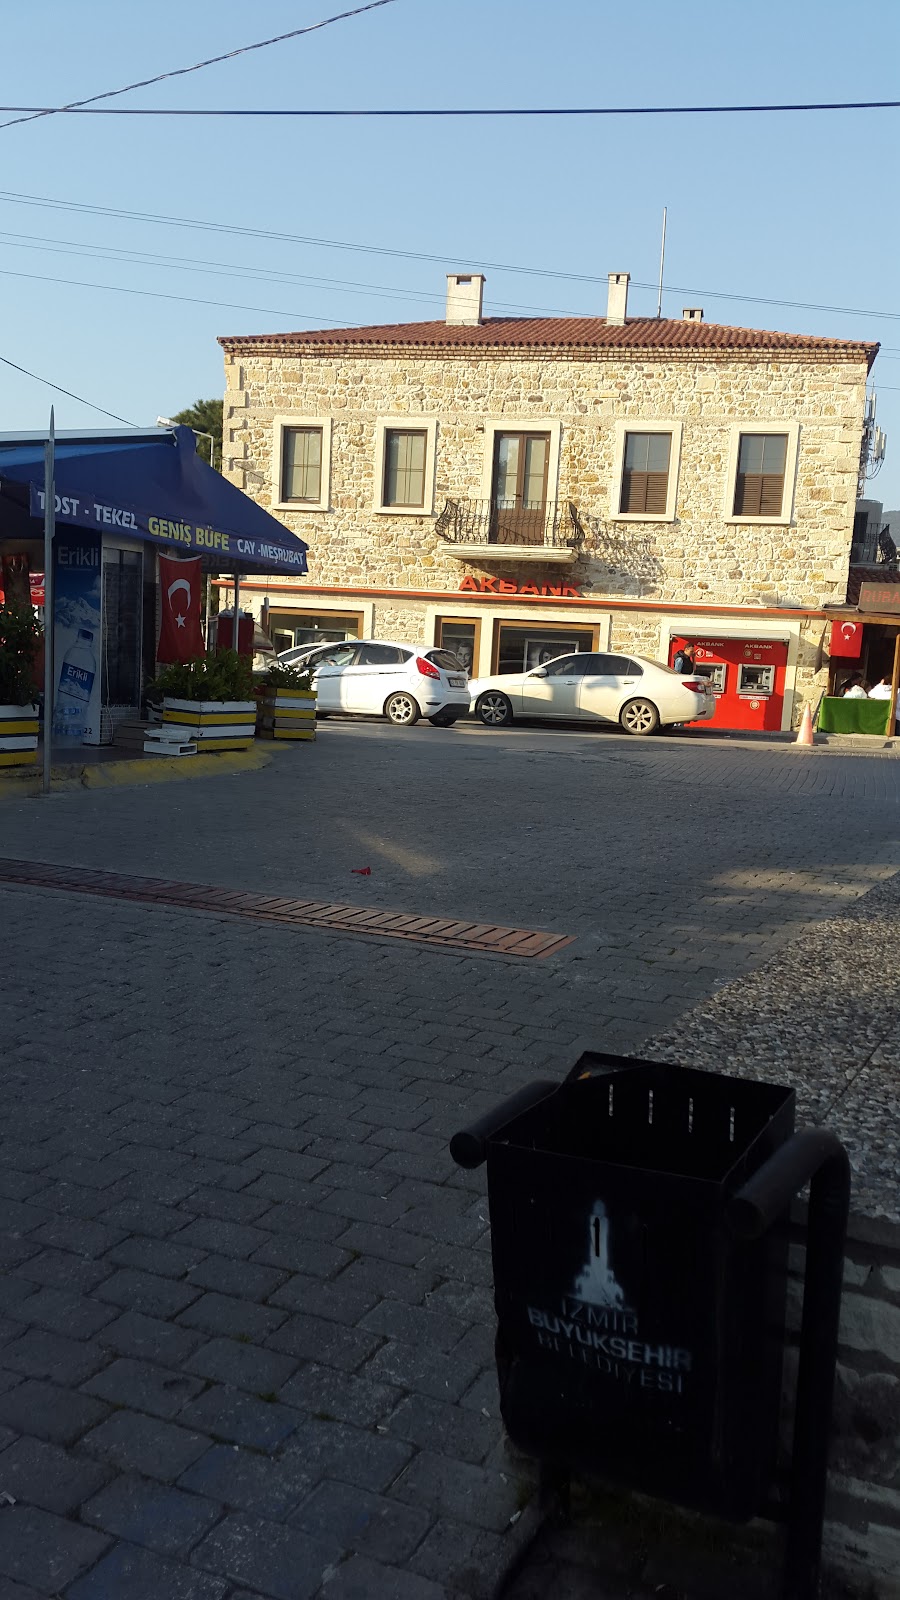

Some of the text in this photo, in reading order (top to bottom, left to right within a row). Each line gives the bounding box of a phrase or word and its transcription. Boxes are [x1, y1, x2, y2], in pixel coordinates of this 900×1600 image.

[93, 503, 138, 530] TEKEL
[148, 517, 230, 551] GENİŞ BÜFE
[57, 546, 99, 566] Erikli
[459, 575, 581, 597] AKBANK
[66, 665, 88, 682] Erikli
